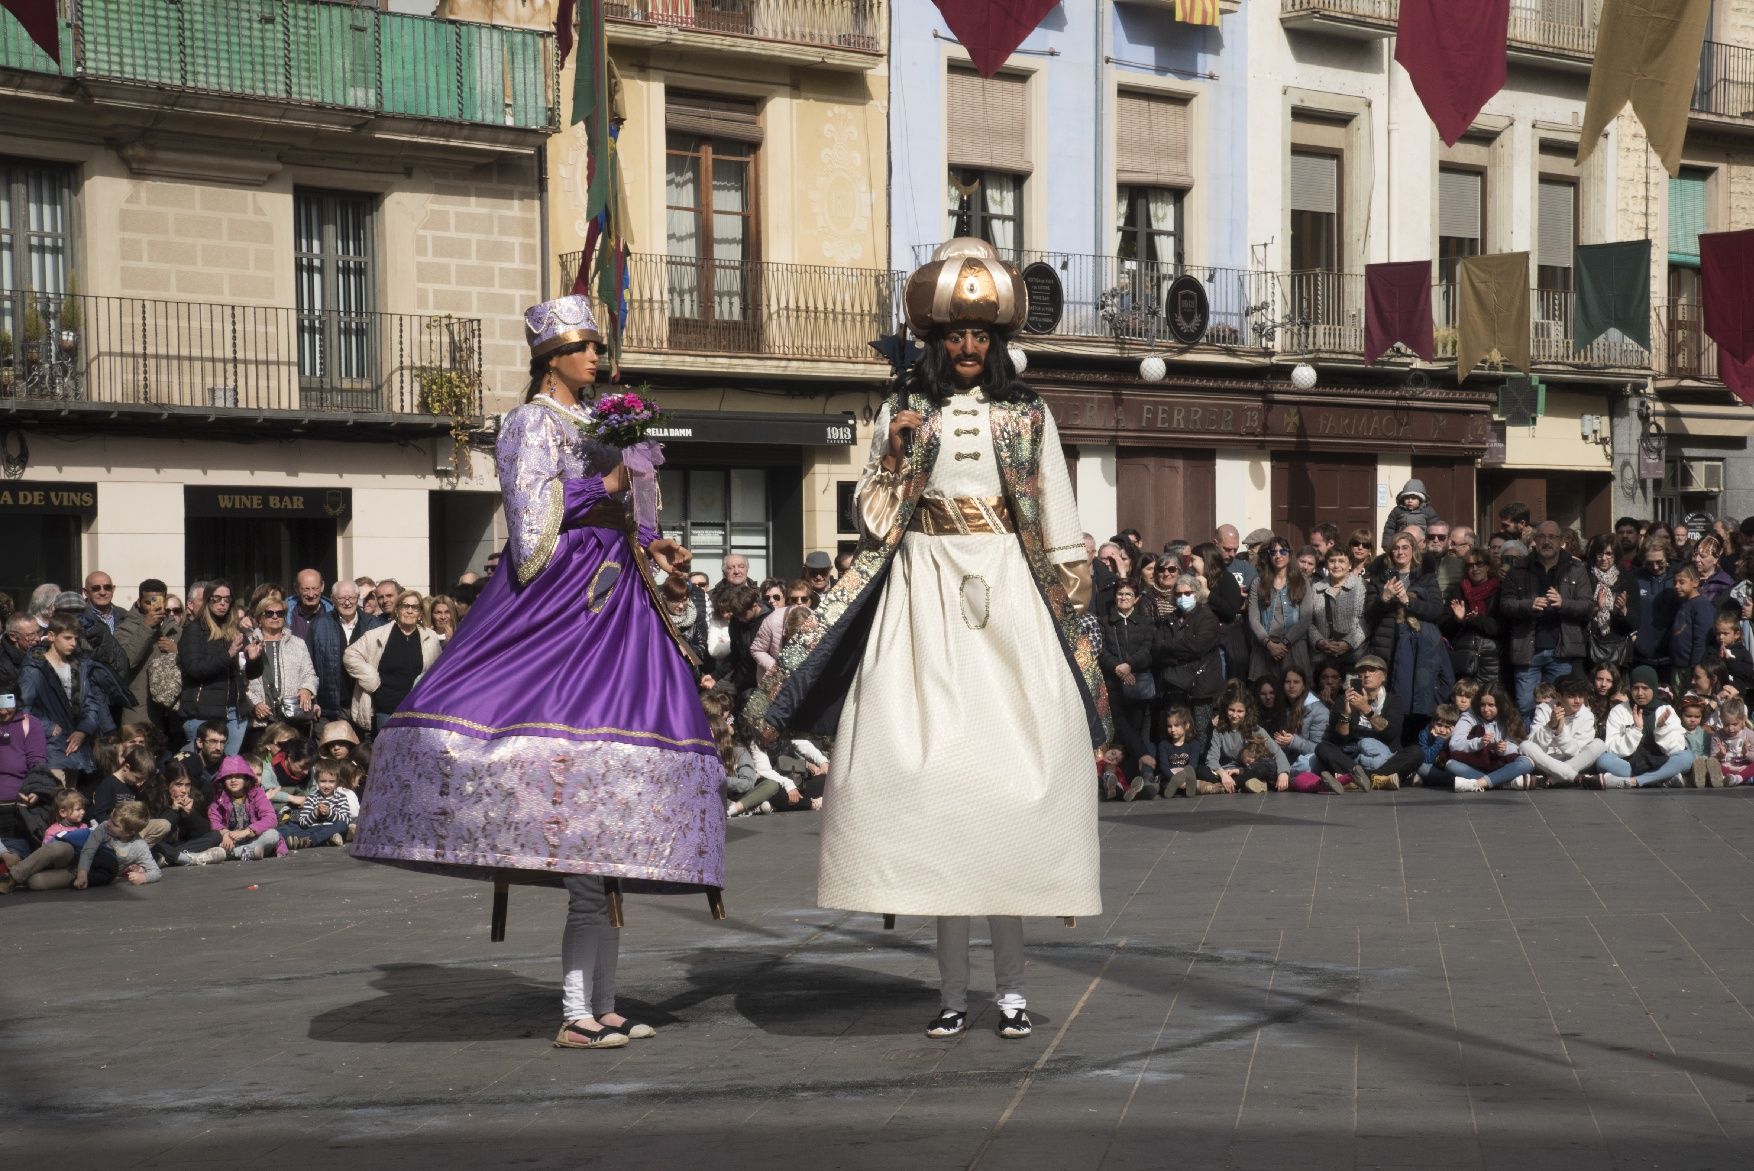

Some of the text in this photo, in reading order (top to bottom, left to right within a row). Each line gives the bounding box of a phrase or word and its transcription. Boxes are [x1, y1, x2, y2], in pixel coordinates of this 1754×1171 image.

[1051, 401, 1259, 431] UERIA FERRER 13
[644, 427, 693, 437] RELLA DAMM
[826, 426, 852, 440] 1913
[18, 491, 46, 505] DE
[49, 491, 94, 507] VINS
[217, 495, 305, 509] WINE BAR
